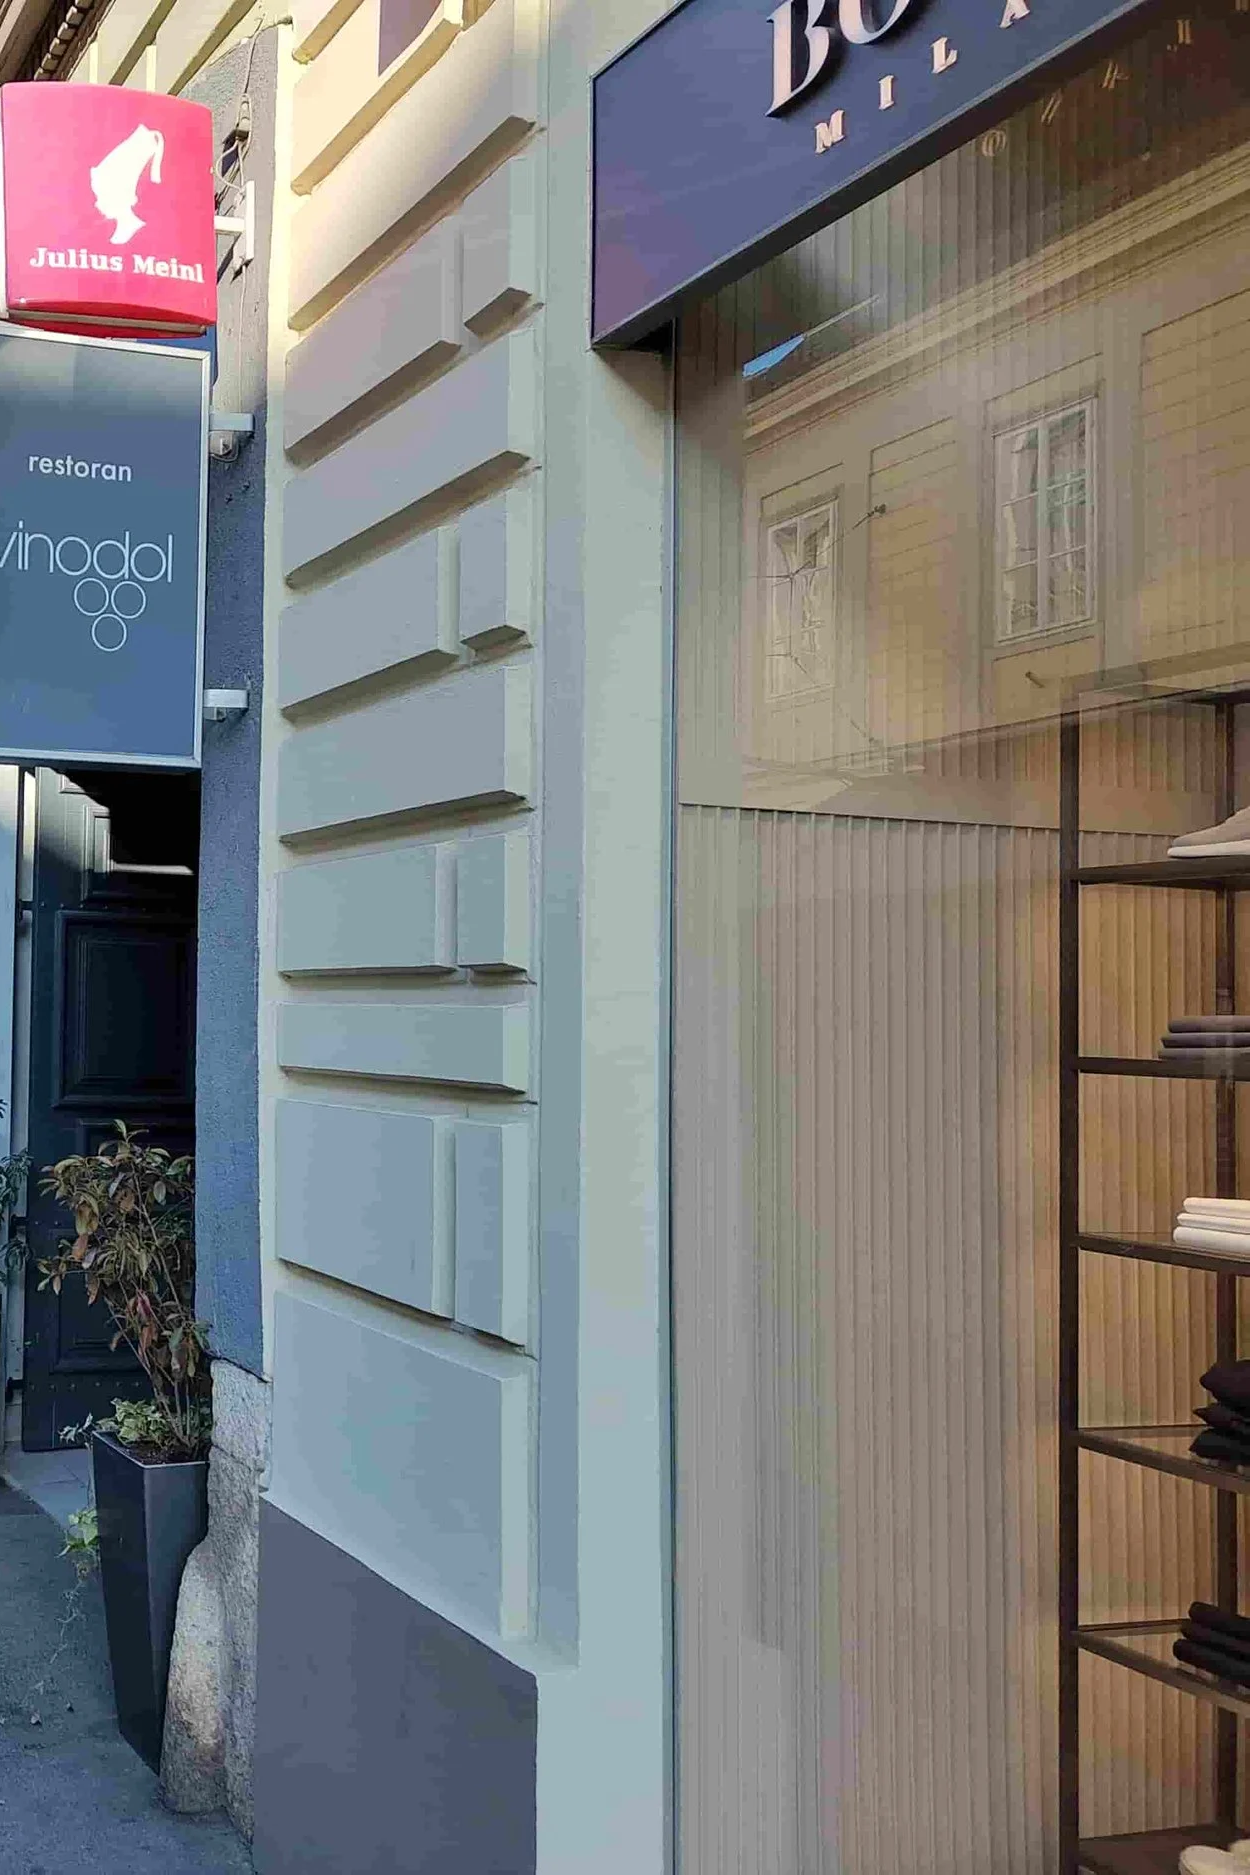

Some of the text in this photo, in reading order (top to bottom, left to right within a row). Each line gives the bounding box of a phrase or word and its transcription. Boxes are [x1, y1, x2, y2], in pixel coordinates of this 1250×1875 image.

[29, 246, 205, 284] Julius Meinl
[28, 455, 132, 482] restoran
